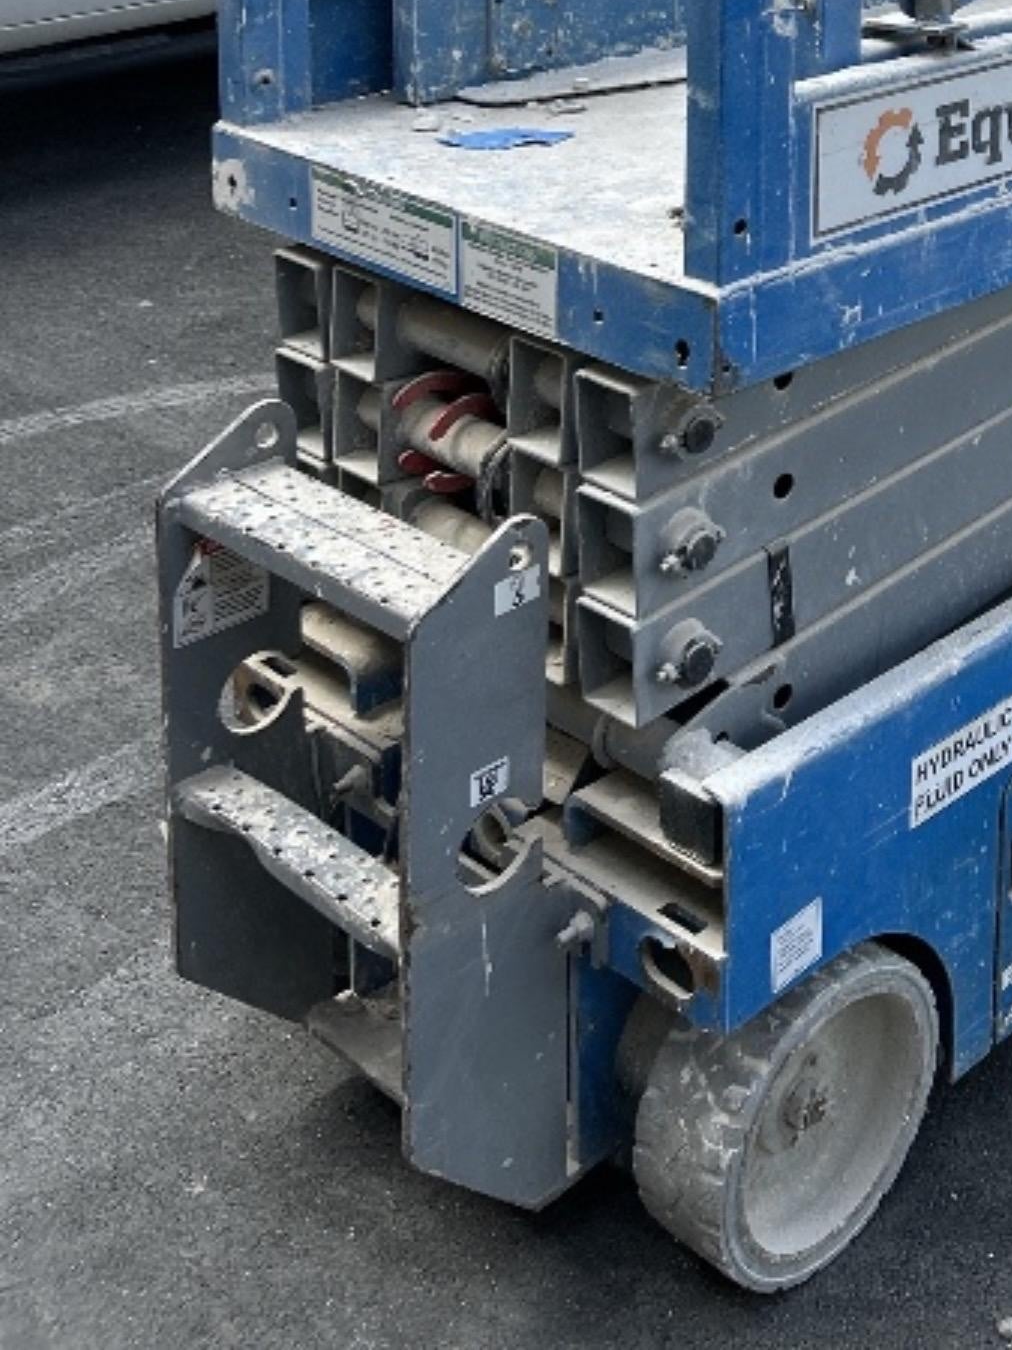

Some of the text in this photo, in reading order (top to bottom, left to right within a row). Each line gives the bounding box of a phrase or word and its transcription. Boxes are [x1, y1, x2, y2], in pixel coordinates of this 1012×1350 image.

[913, 735, 1012, 821] FLUID ONLY
[915, 706, 1012, 785] HYDRAULIC
